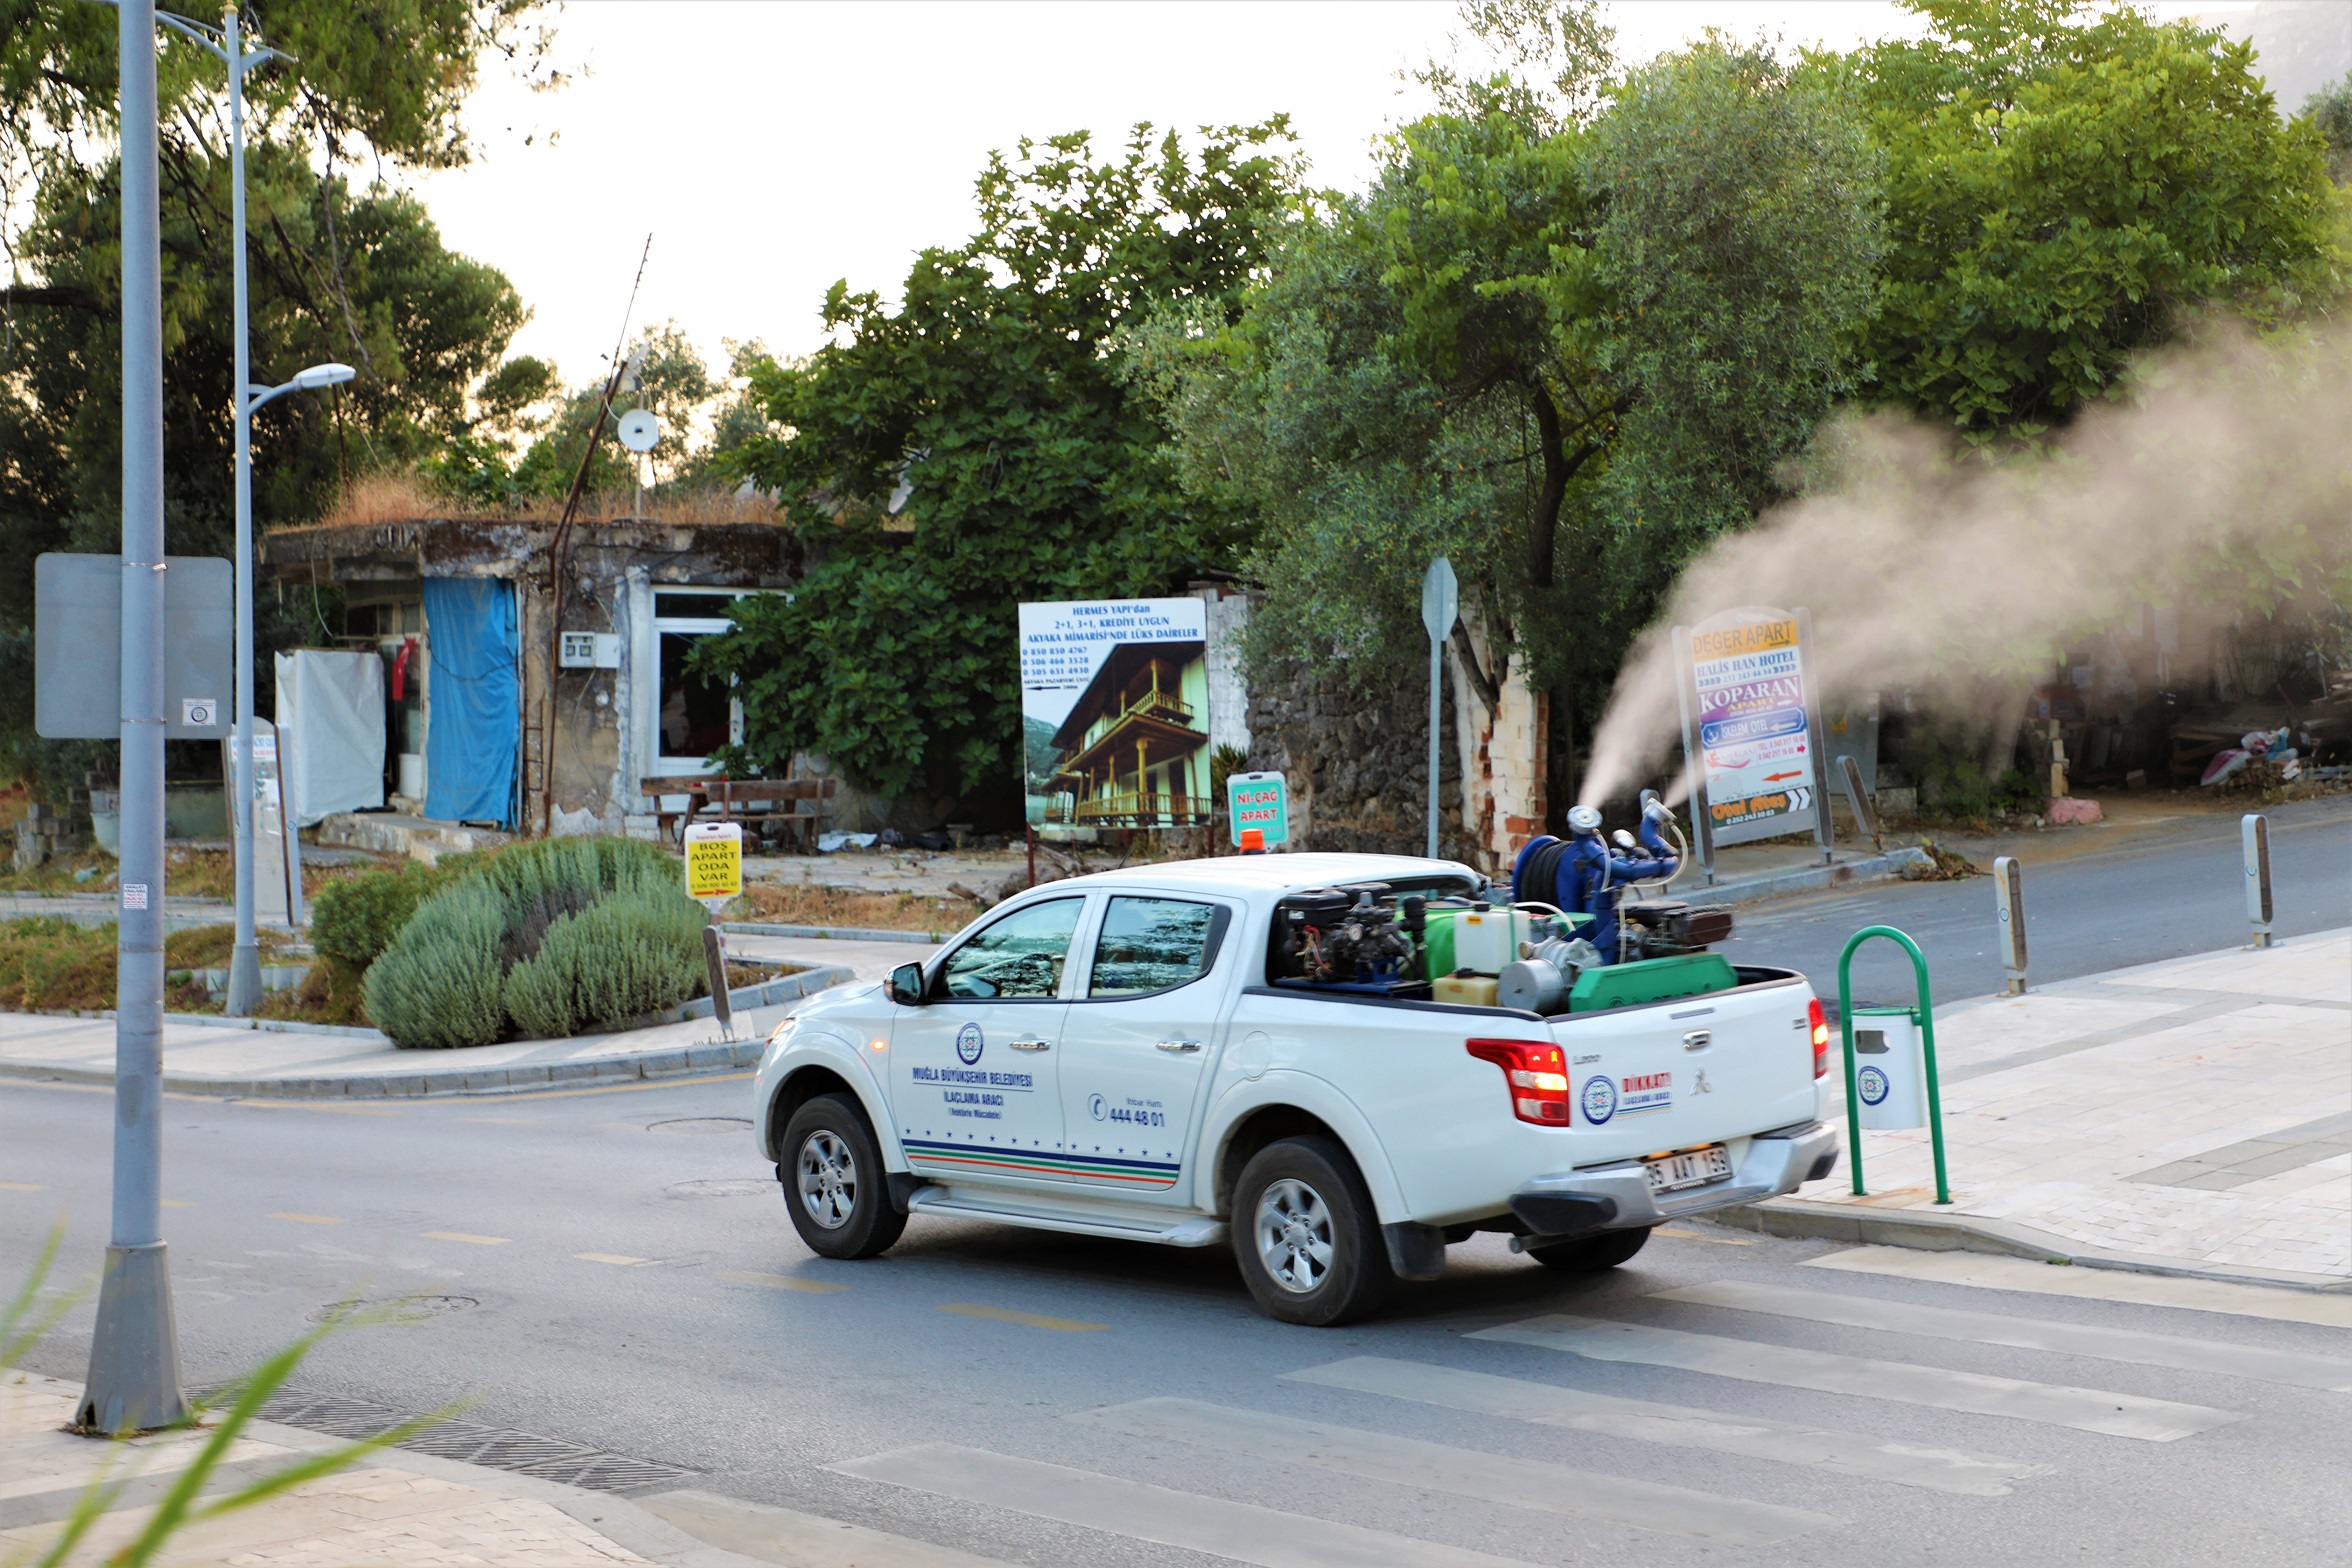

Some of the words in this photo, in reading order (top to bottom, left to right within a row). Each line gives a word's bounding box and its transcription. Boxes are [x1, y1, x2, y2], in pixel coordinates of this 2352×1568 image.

[1072, 606, 1108, 616] HERMES
[1054, 620, 1074, 630] 2+1,
[1077, 619, 1096, 629] 3+1,
[1099, 616, 1136, 628] KREDİYE
[1139, 616, 1170, 626] UYGUN
[1027, 633, 1062, 643] AKYAKA
[1131, 628, 1154, 639] LÜKS
[1156, 627, 1198, 638] DAİRELER
[1746, 621, 1792, 645] APART
[1022, 648, 1028, 656] 0
[1022, 658, 1028, 666] 0
[1732, 658, 1756, 673] HAN
[1759, 651, 1796, 667] HOTEL
[1022, 668, 1029, 676] 0
[1699, 677, 1800, 714] KOPARAN
[1727, 698, 1774, 712] APART
[1750, 719, 1768, 733] OTEL
[1240, 809, 1277, 822] APART
[1711, 800, 1746, 820] Otel
[699, 842, 728, 851] BOŞ
[690, 851, 736, 861] APART
[698, 862, 730, 871] ODA
[699, 872, 728, 881] VAR
[912, 1066, 939, 1080] MUĞLA
[1110, 1108, 1132, 1124] 444
[1134, 1110, 1149, 1126] 48
[1150, 1111, 1165, 1127] 01
